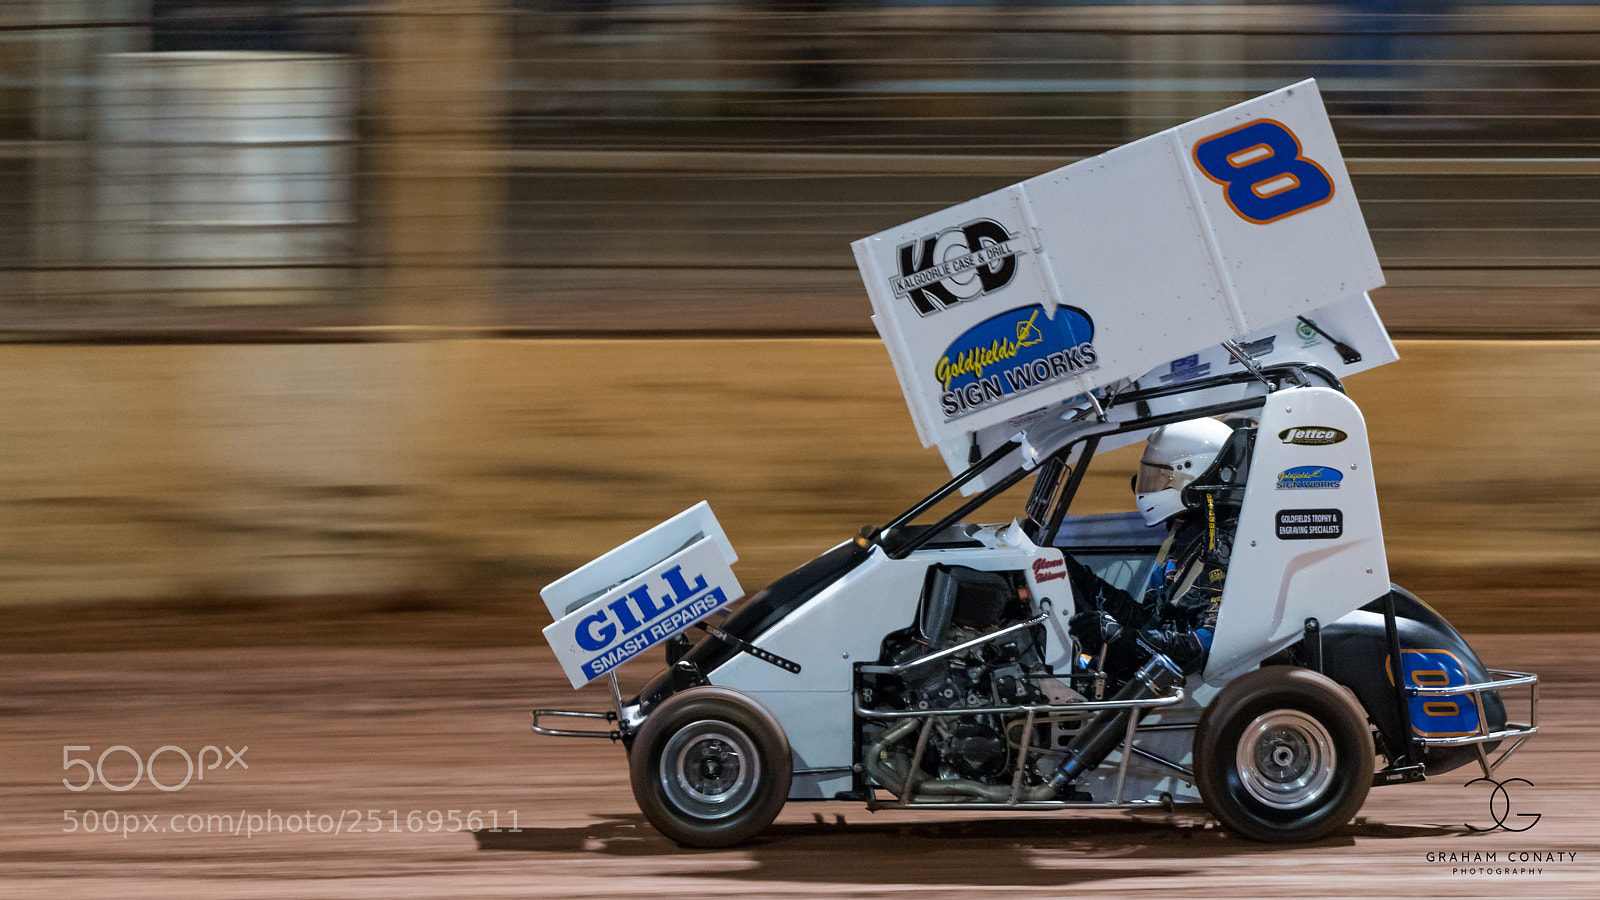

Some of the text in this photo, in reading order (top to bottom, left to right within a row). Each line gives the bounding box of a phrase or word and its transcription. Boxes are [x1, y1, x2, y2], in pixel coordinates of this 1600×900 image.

[1192, 118, 1335, 225] 8
[895, 243, 1013, 291] KALGOORLIE CASE & DRILL
[935, 337, 1020, 390] Goldfields
[941, 374, 1003, 417] SIGN
[1003, 342, 1098, 393] WORKS
[1276, 480, 1341, 489] SIGN WORKS
[1279, 525, 1340, 535] ENGRAVING SPECIALISTS
[1281, 514, 1337, 523] GOLDFIELDS TROPHY &
[574, 564, 709, 652] GILL
[591, 594, 719, 674] SMASH REPAIRS
